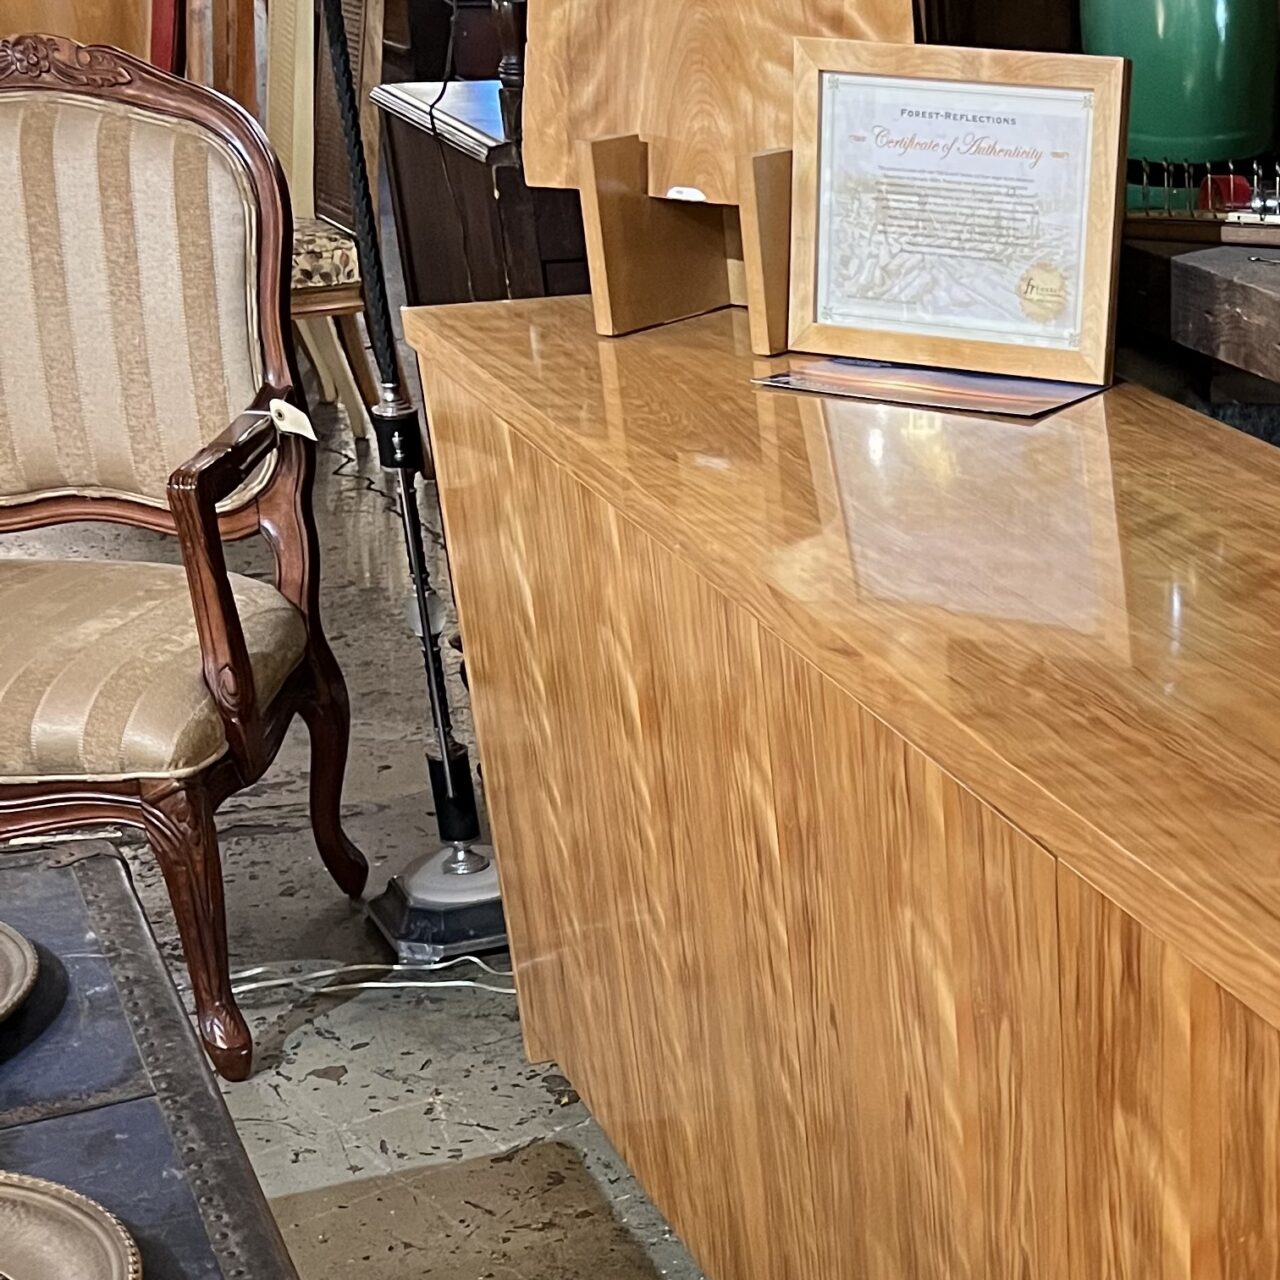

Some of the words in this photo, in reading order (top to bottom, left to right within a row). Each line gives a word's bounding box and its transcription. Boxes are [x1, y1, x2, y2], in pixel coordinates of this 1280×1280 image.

[872, 125, 939, 157] Certificate
[938, 136, 959, 160] of
[957, 132, 1044, 169] Authenticity
